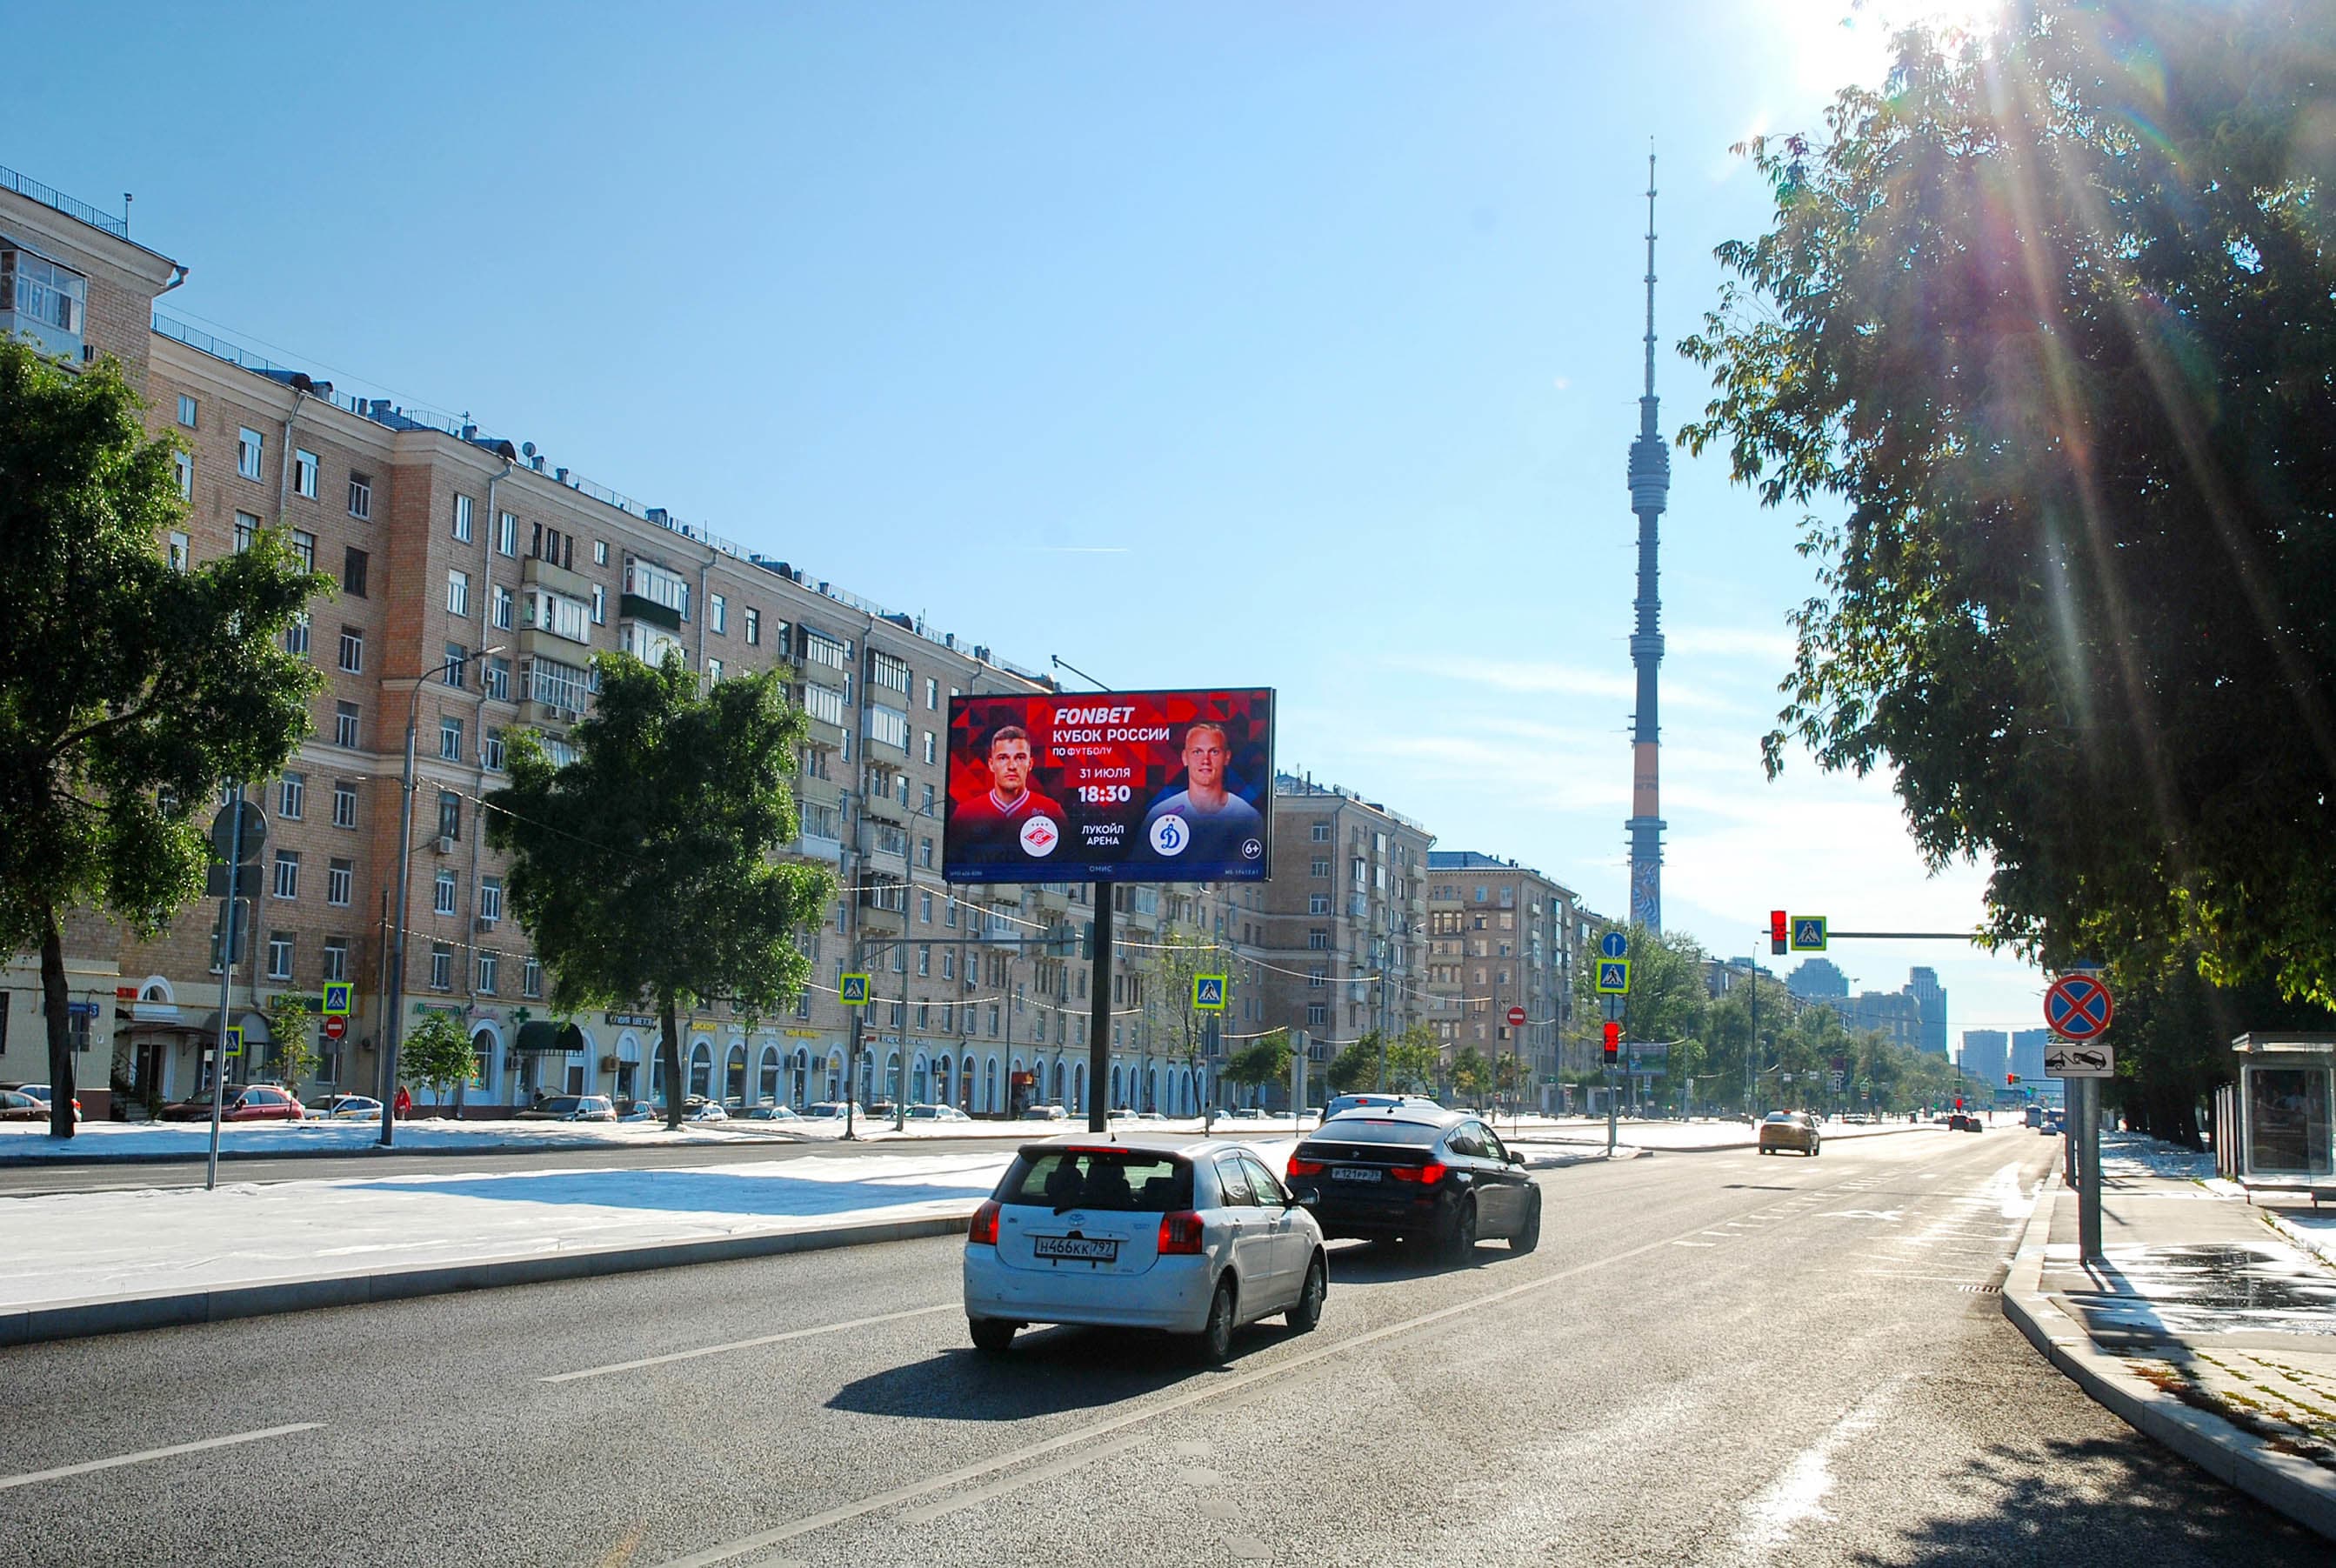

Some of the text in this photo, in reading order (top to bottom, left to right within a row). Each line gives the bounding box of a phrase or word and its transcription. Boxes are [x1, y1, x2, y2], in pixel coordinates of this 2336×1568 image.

[1053, 706, 1135, 724] FONBET
[1052, 727, 1170, 743] КУБОК РОССИИ
[1052, 746, 1112, 756] ПО ФУТБОЛУ
[1079, 767, 1131, 778] 31 ИЮЛЯ
[1078, 784, 1131, 803] 18:30
[1081, 822, 1125, 835] ЛУКОЙЛ
[1086, 836, 1120, 845] АРЕНА
[1245, 843, 1259, 854] 6+
